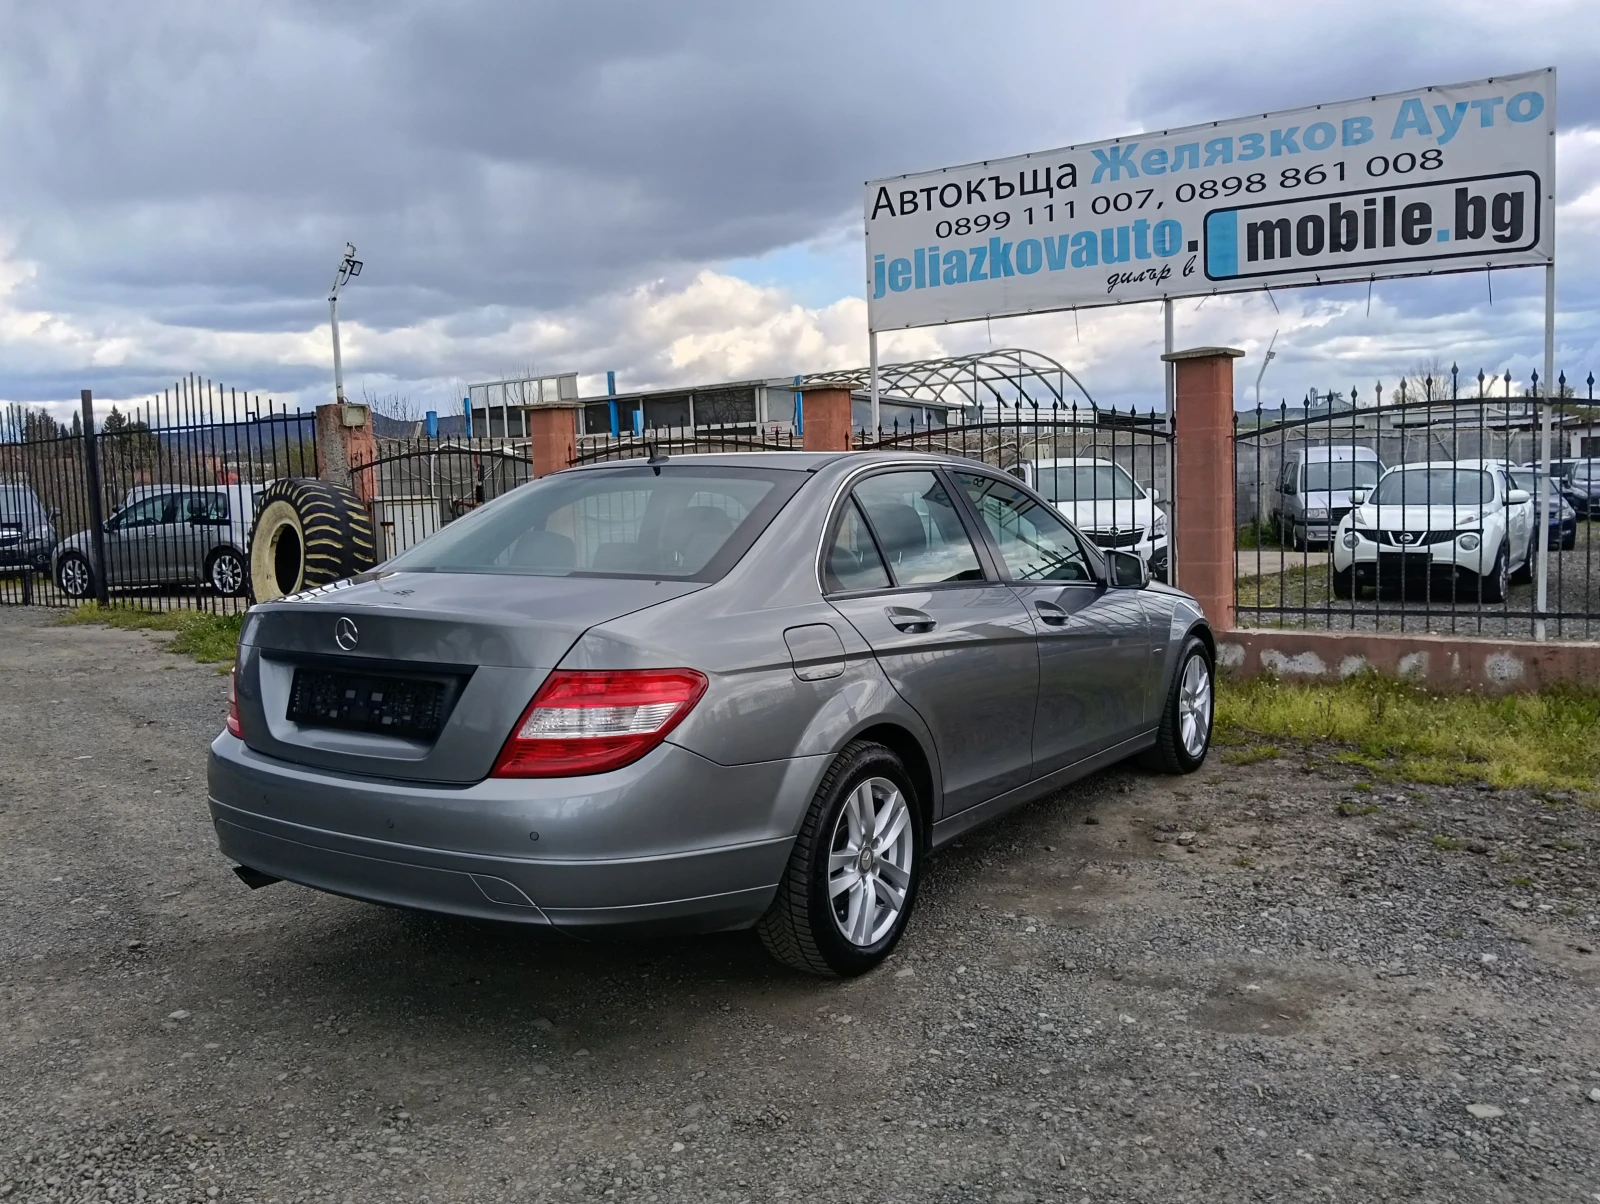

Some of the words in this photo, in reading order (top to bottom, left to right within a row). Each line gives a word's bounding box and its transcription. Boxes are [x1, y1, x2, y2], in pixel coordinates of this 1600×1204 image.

[871, 163, 1077, 220] Автокъща
[1091, 116, 1375, 184] Желязков
[1391, 91, 1545, 145] Ауто
[935, 211, 1011, 239] 0899
[1024, 201, 1077, 225] 111
[1091, 189, 1164, 215] 007,
[1175, 173, 1267, 203] 0898
[1279, 161, 1346, 189] 861
[1366, 149, 1444, 177] 008
[1247, 187, 1525, 262] mobile.bg
[1106, 263, 1172, 293] дилър
